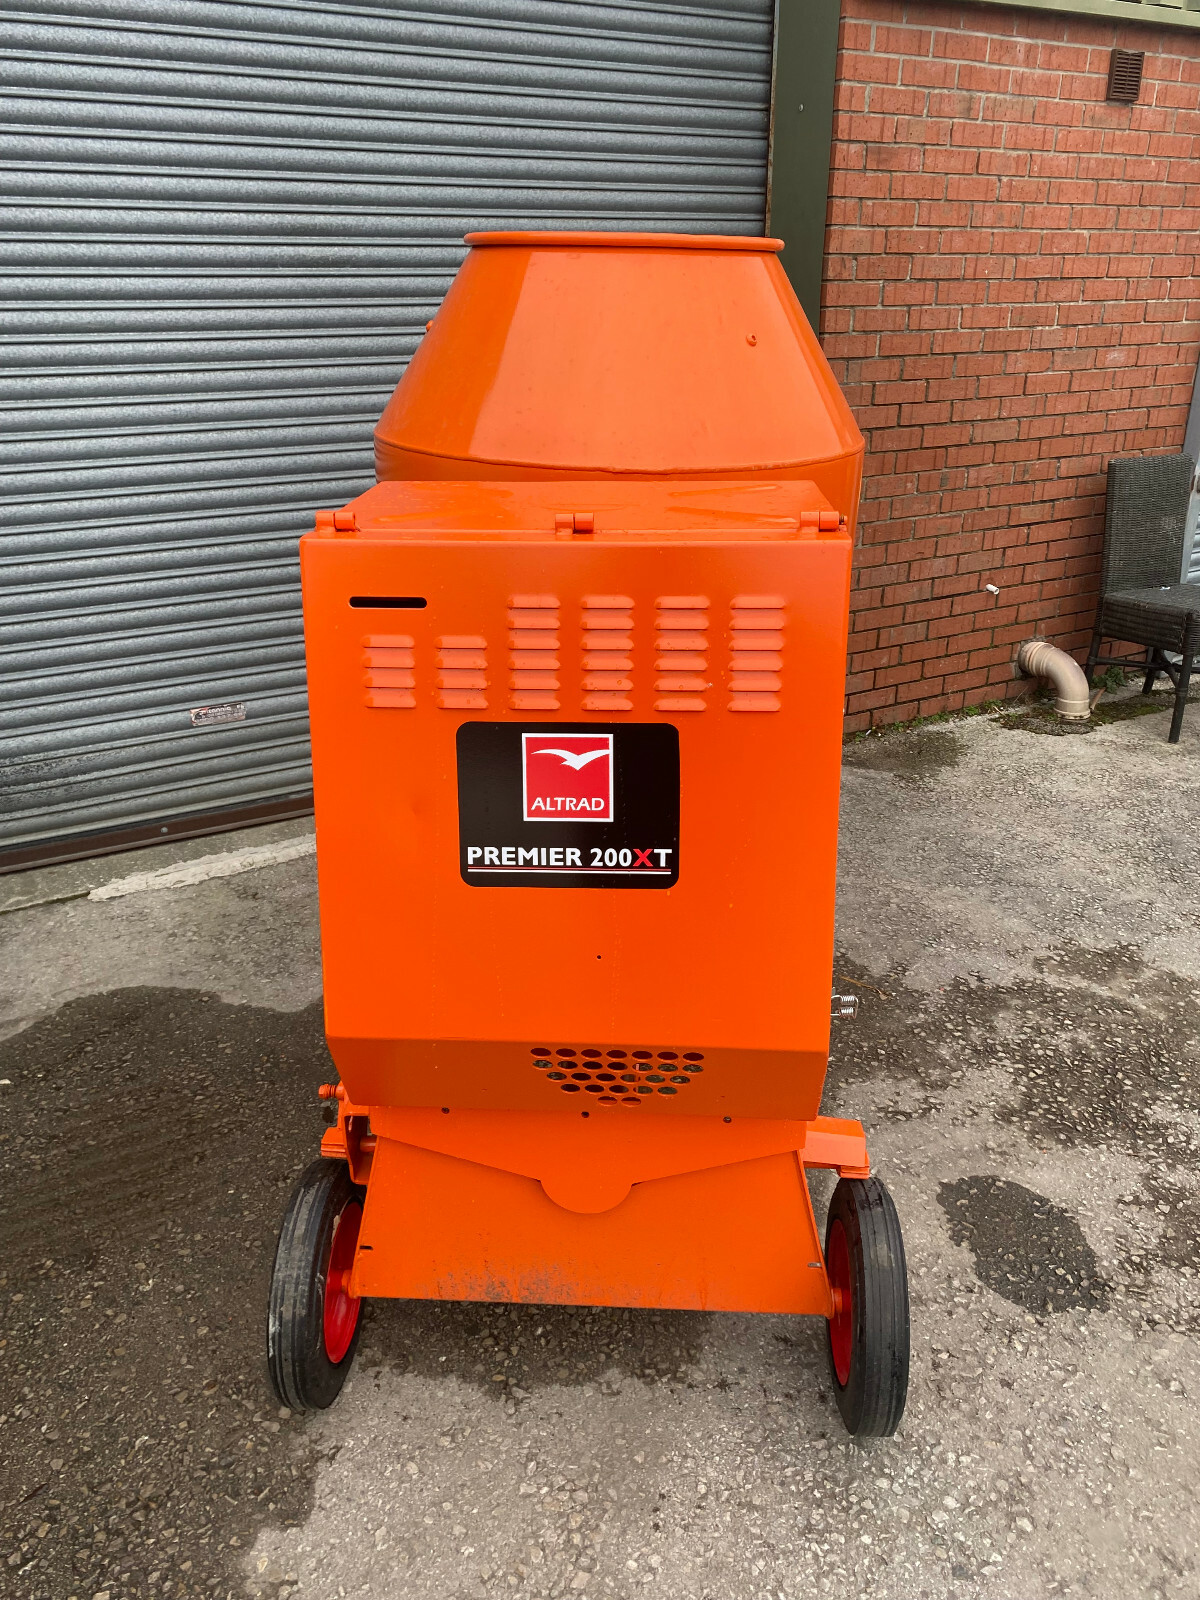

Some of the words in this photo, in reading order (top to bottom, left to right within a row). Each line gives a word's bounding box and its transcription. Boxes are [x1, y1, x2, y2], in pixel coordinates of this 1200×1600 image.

[531, 797, 605, 811] ALTRAD
[467, 846, 582, 867] PREMIER
[590, 848, 672, 868] 200XT
